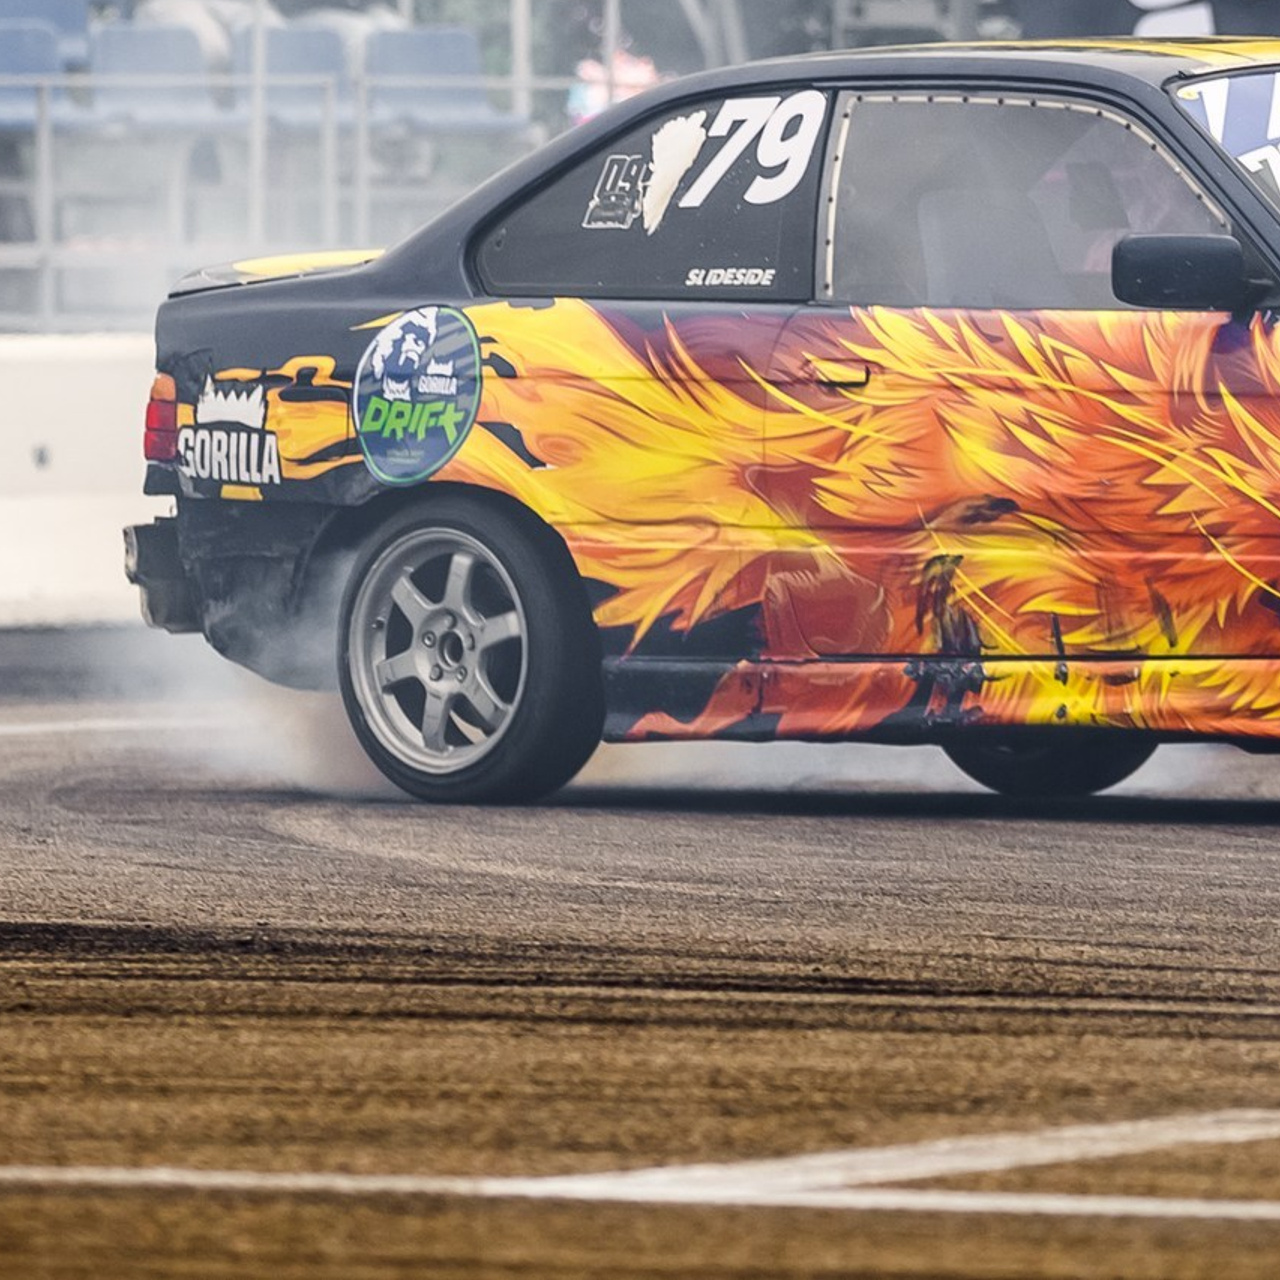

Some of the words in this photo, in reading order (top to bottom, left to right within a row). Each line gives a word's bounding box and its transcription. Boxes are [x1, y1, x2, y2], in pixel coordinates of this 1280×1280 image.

[679, 90, 827, 208] 79
[684, 268, 776, 286] SLIDESIDE
[178, 426, 281, 485] GORILLA
